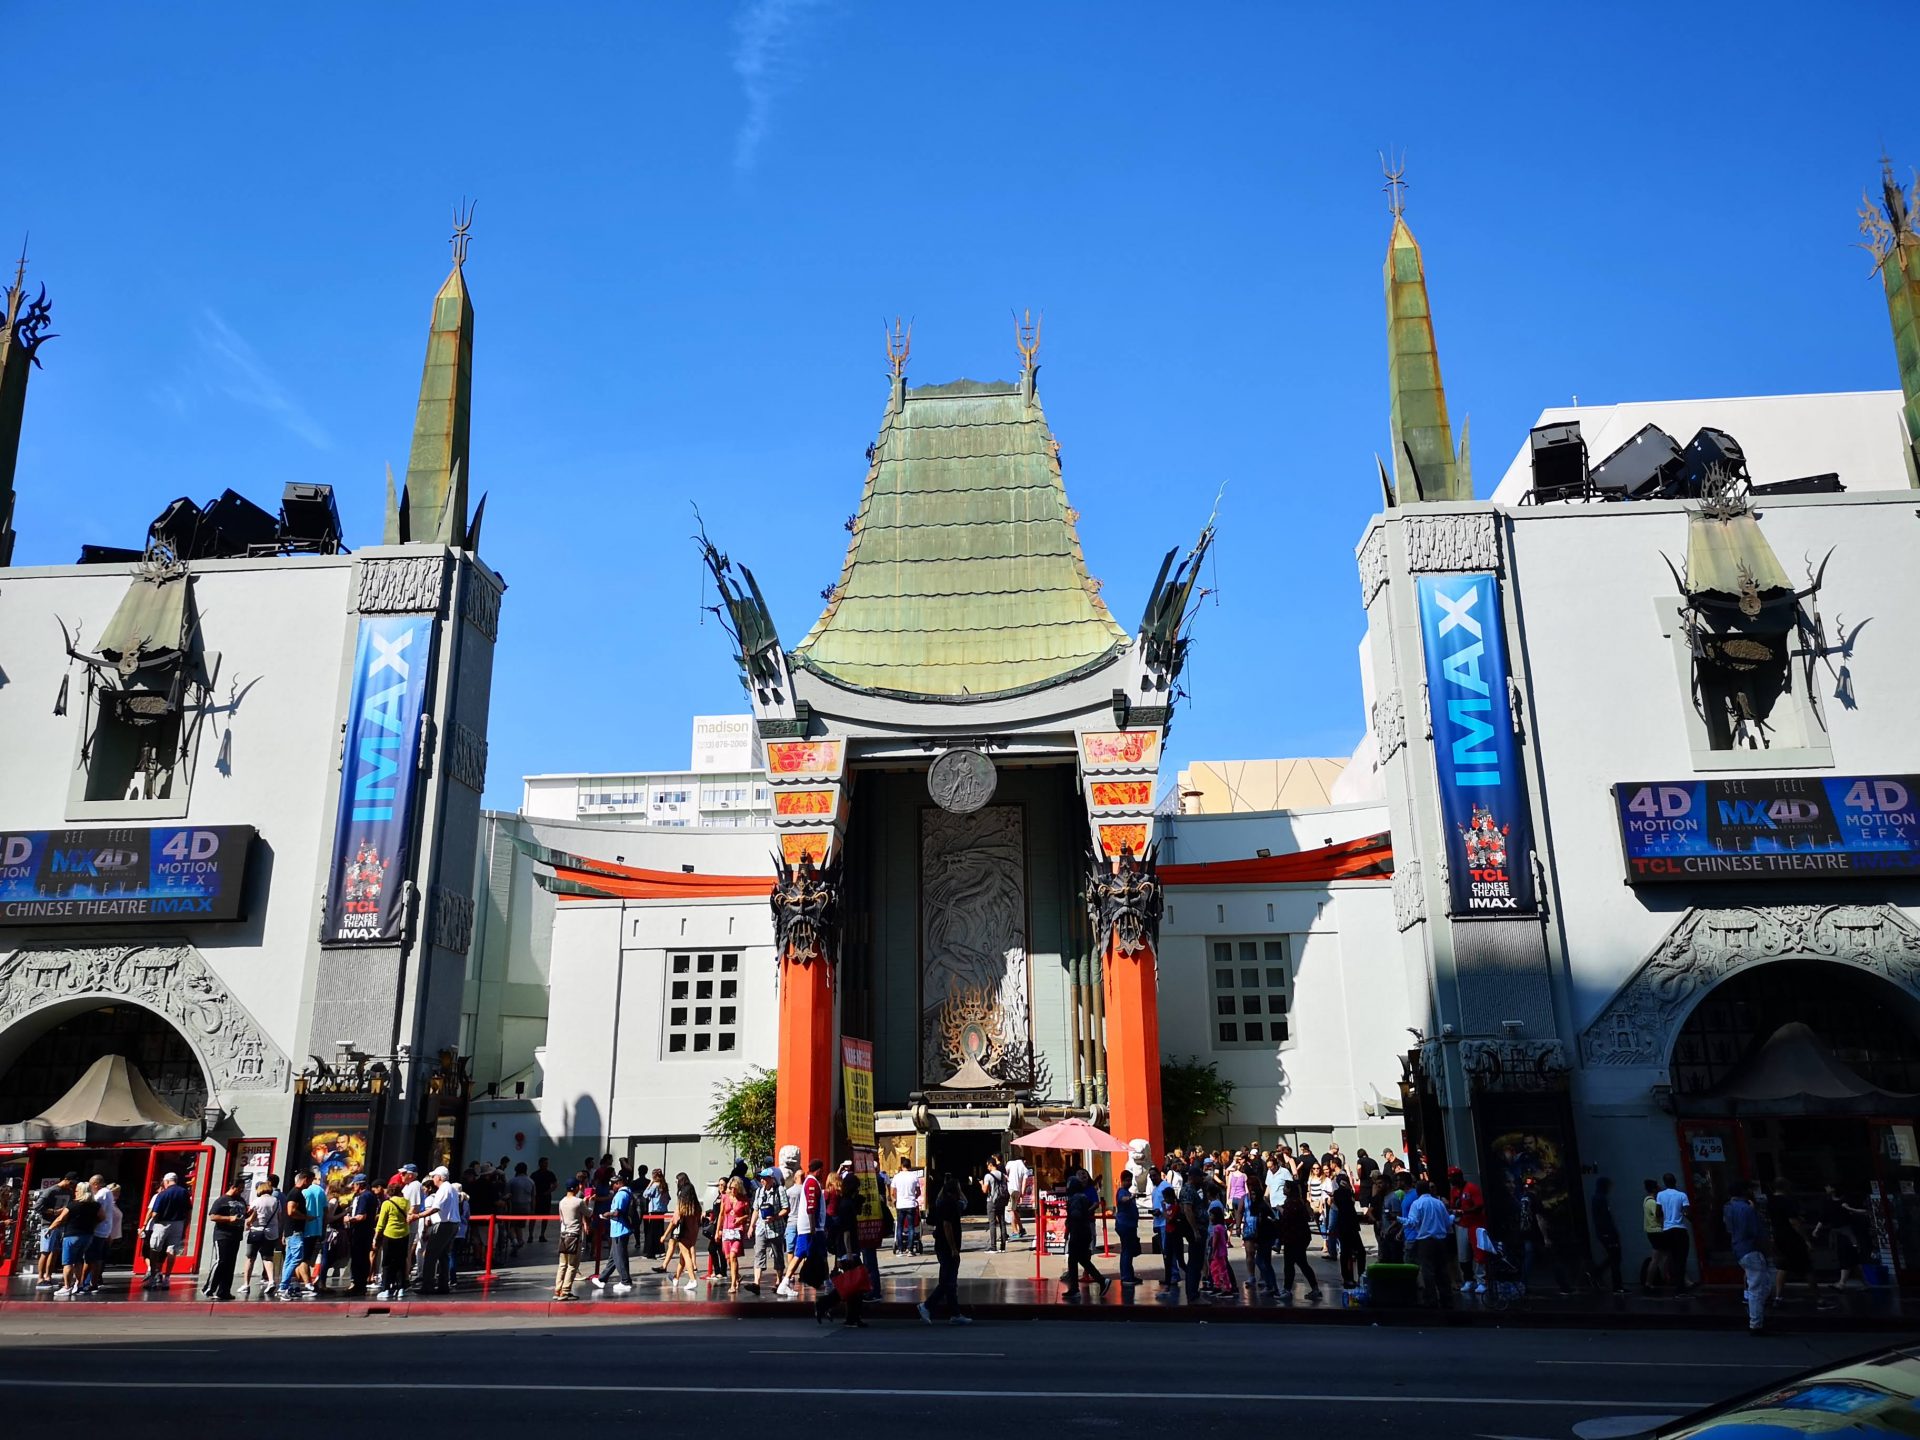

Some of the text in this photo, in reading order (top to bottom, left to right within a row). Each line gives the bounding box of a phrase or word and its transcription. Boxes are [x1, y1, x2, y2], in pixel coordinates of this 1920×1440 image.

[1434, 585, 1500, 786] IMAX
[352, 628, 413, 821] IMAX
[697, 720, 749, 734] madison
[1724, 779, 1805, 794] SEE FEEL
[1628, 787, 1692, 817] 4D
[1844, 780, 1908, 812] 4D
[1717, 798, 1819, 829] MX4D
[1846, 813, 1916, 826] MOTION
[1630, 819, 1698, 832] MOTION
[64, 829, 134, 843] SEE FEEL
[1644, 833, 1687, 844] EFX
[1861, 827, 1907, 839] EFX
[0, 836, 32, 865] D
[162, 831, 219, 860] 4D
[158, 861, 218, 874] MOTION
[1632, 858, 1681, 874] TCL
[1684, 855, 1763, 872] CHINESE
[1765, 854, 1849, 870] THEATRE
[167, 875, 205, 886] EFX
[1469, 869, 1509, 882] TCL
[1471, 882, 1509, 890] CHINESE
[1472, 889, 1510, 897] THEATRE
[6, 898, 213, 917] CHINESE THEATRE IMAX
[345, 901, 380, 913] TCL
[1468, 897, 1518, 908] IMAX
[344, 913, 378, 921] CHINESE
[344, 920, 378, 928] THEATRE
[338, 927, 383, 939] IMAX
[242, 1146, 272, 1155] SHIRTS
